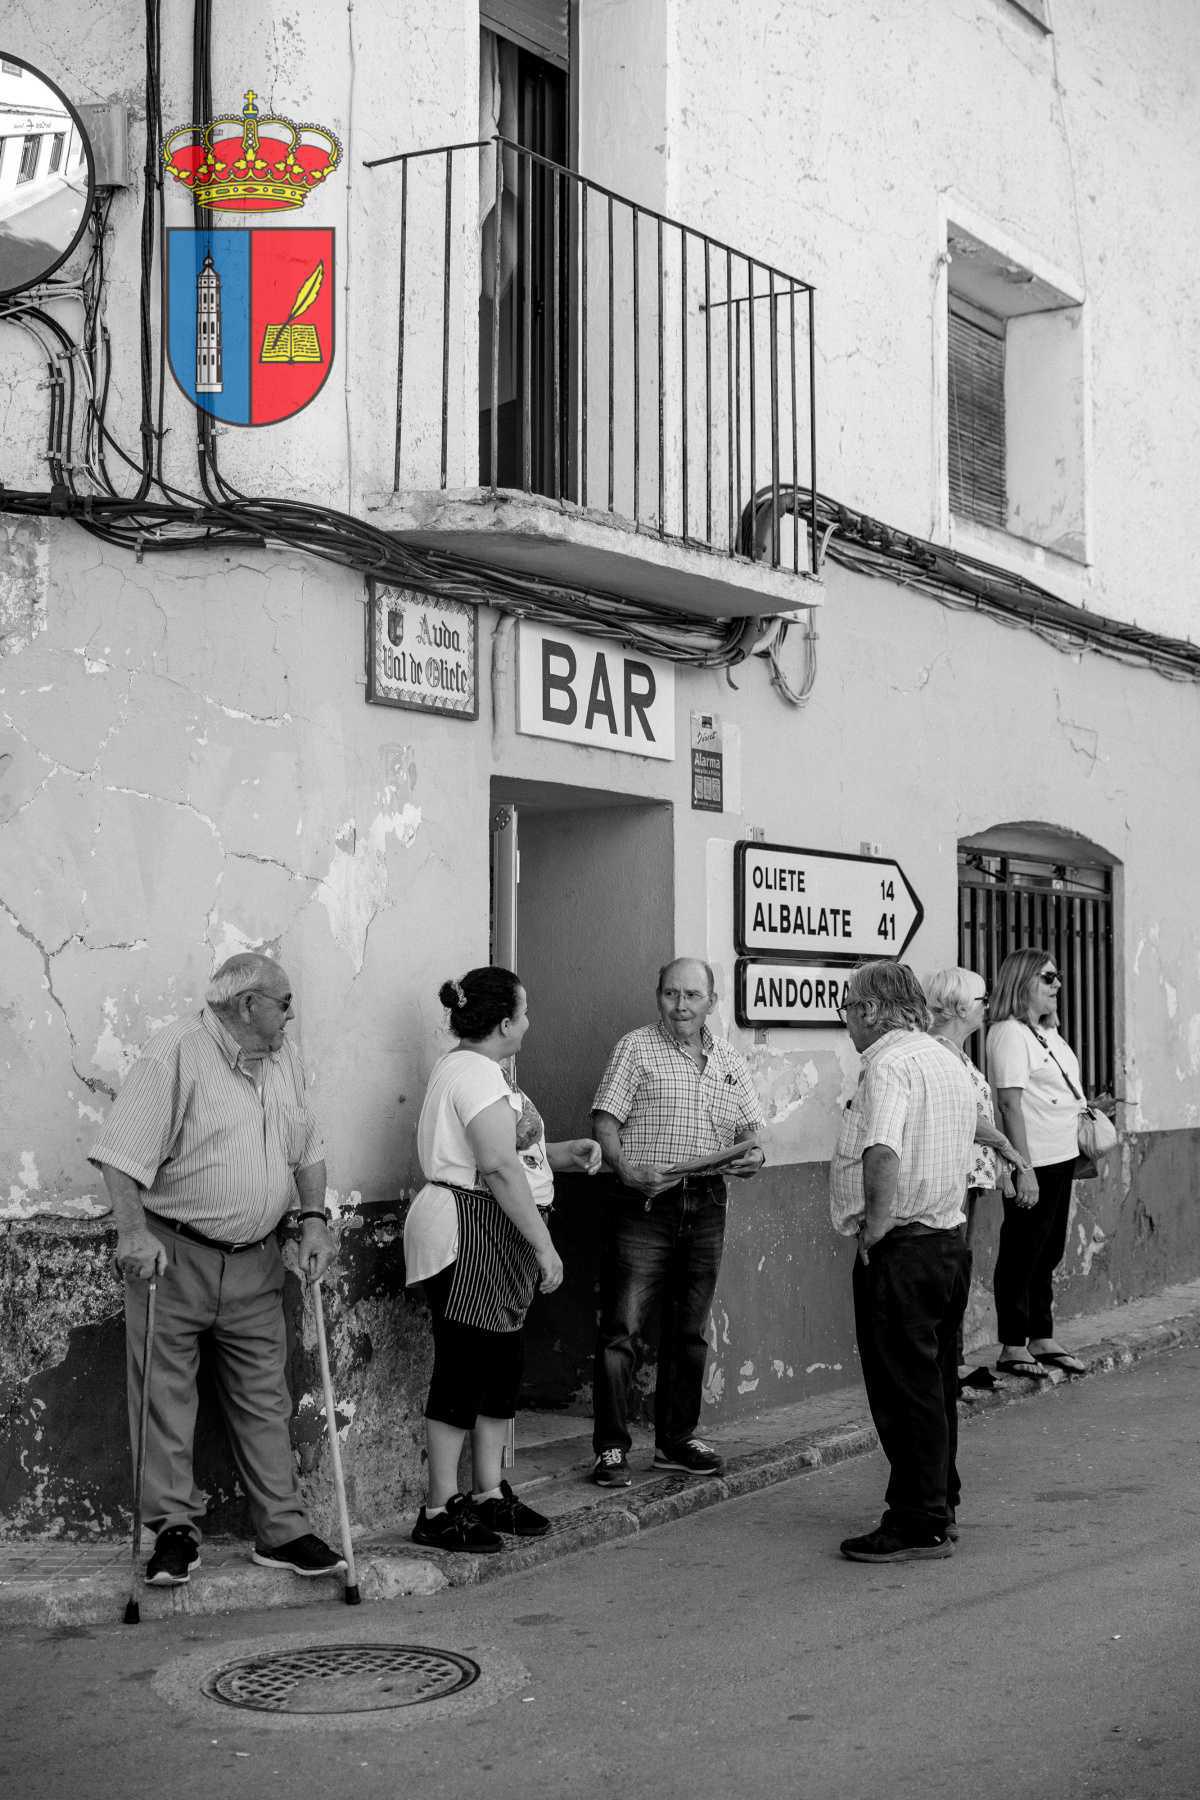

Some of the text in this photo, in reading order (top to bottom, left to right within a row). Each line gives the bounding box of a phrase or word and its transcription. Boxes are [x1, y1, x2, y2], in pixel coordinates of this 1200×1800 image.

[383, 644, 468, 694] Val de Oliete
[542, 638, 657, 742] BAR
[694, 752, 720, 769] Alarma
[752, 865, 895, 902] OLIETE 14
[752, 902, 896, 940] ALBALATE 41
